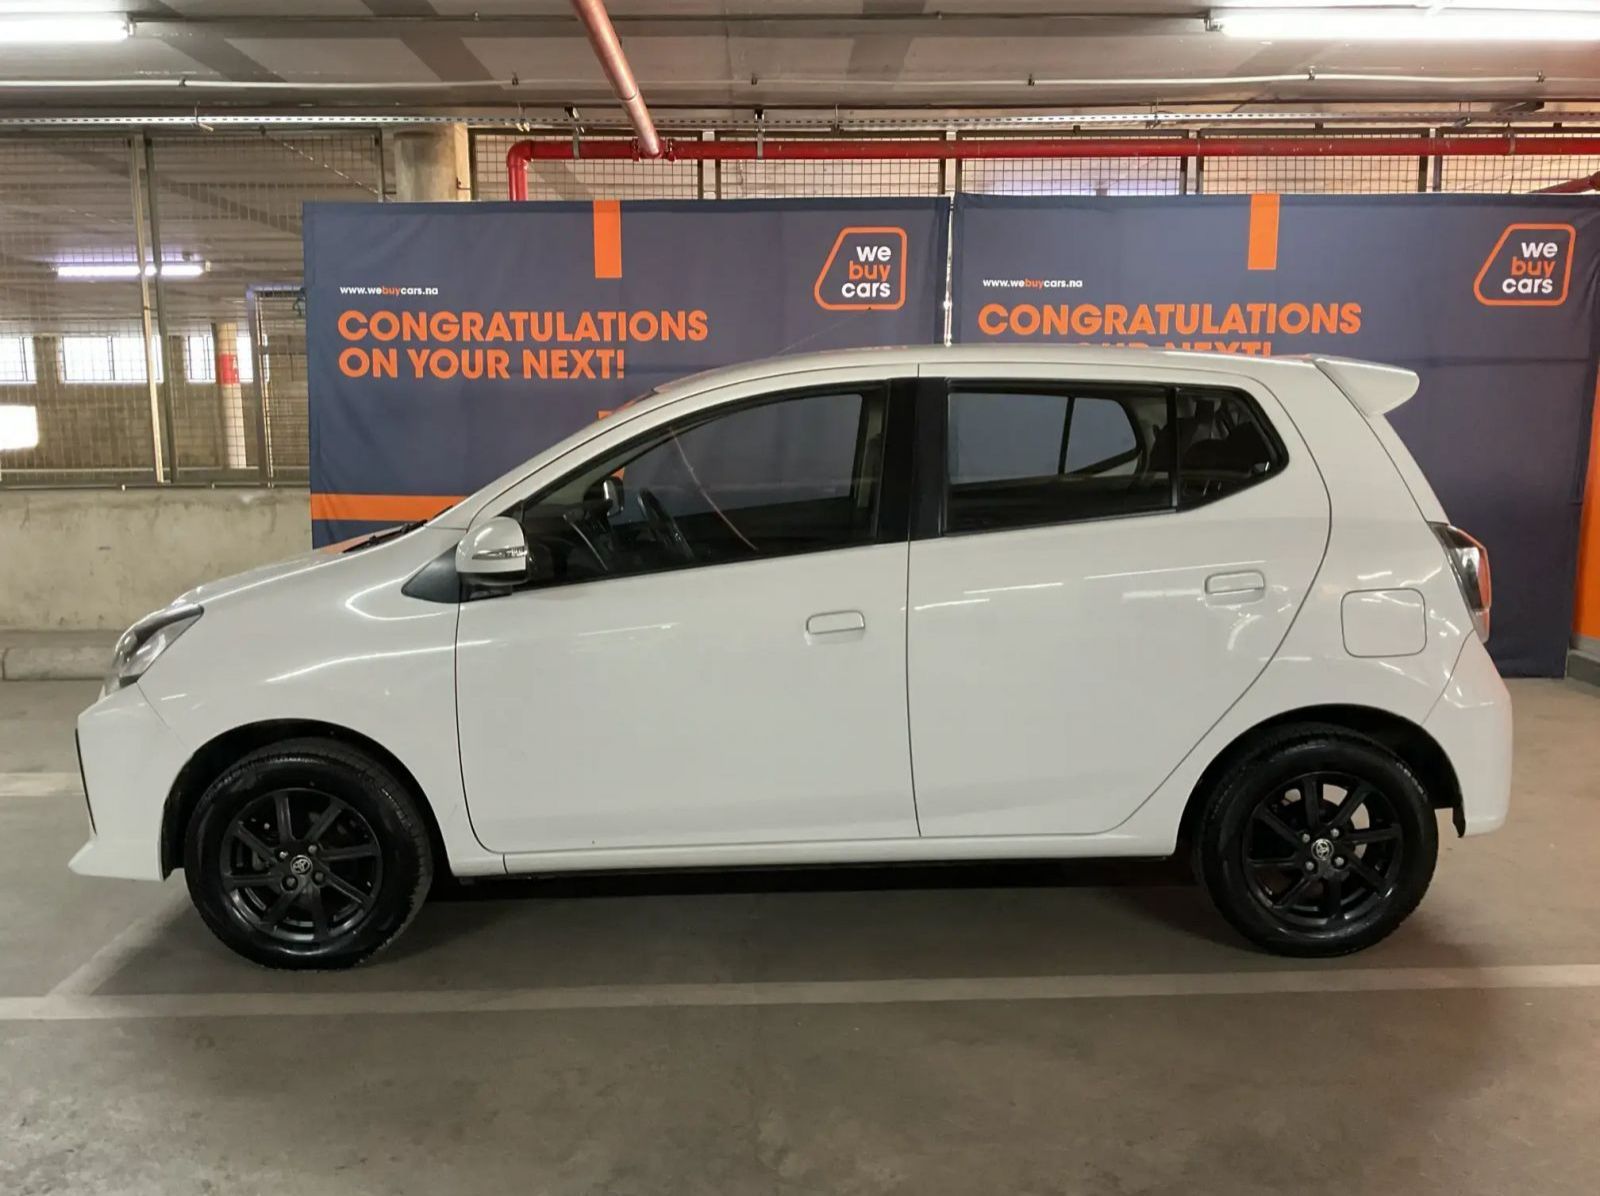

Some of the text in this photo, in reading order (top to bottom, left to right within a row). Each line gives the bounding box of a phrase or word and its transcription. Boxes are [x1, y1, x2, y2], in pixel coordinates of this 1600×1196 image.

[856, 246, 892, 262] we
[1521, 242, 1558, 258] we
[849, 260, 891, 282] buy
[1511, 256, 1556, 279] buy
[340, 285, 439, 297] www.webuycars.na
[841, 282, 891, 298] cars
[983, 278, 1083, 290] www.webuycars.na
[1502, 278, 1553, 294] cars
[337, 309, 709, 342] CONGRATULATIONS
[977, 302, 1362, 336] CONGRATULATIONS
[338, 348, 626, 380] ON YOUR NEXT!
